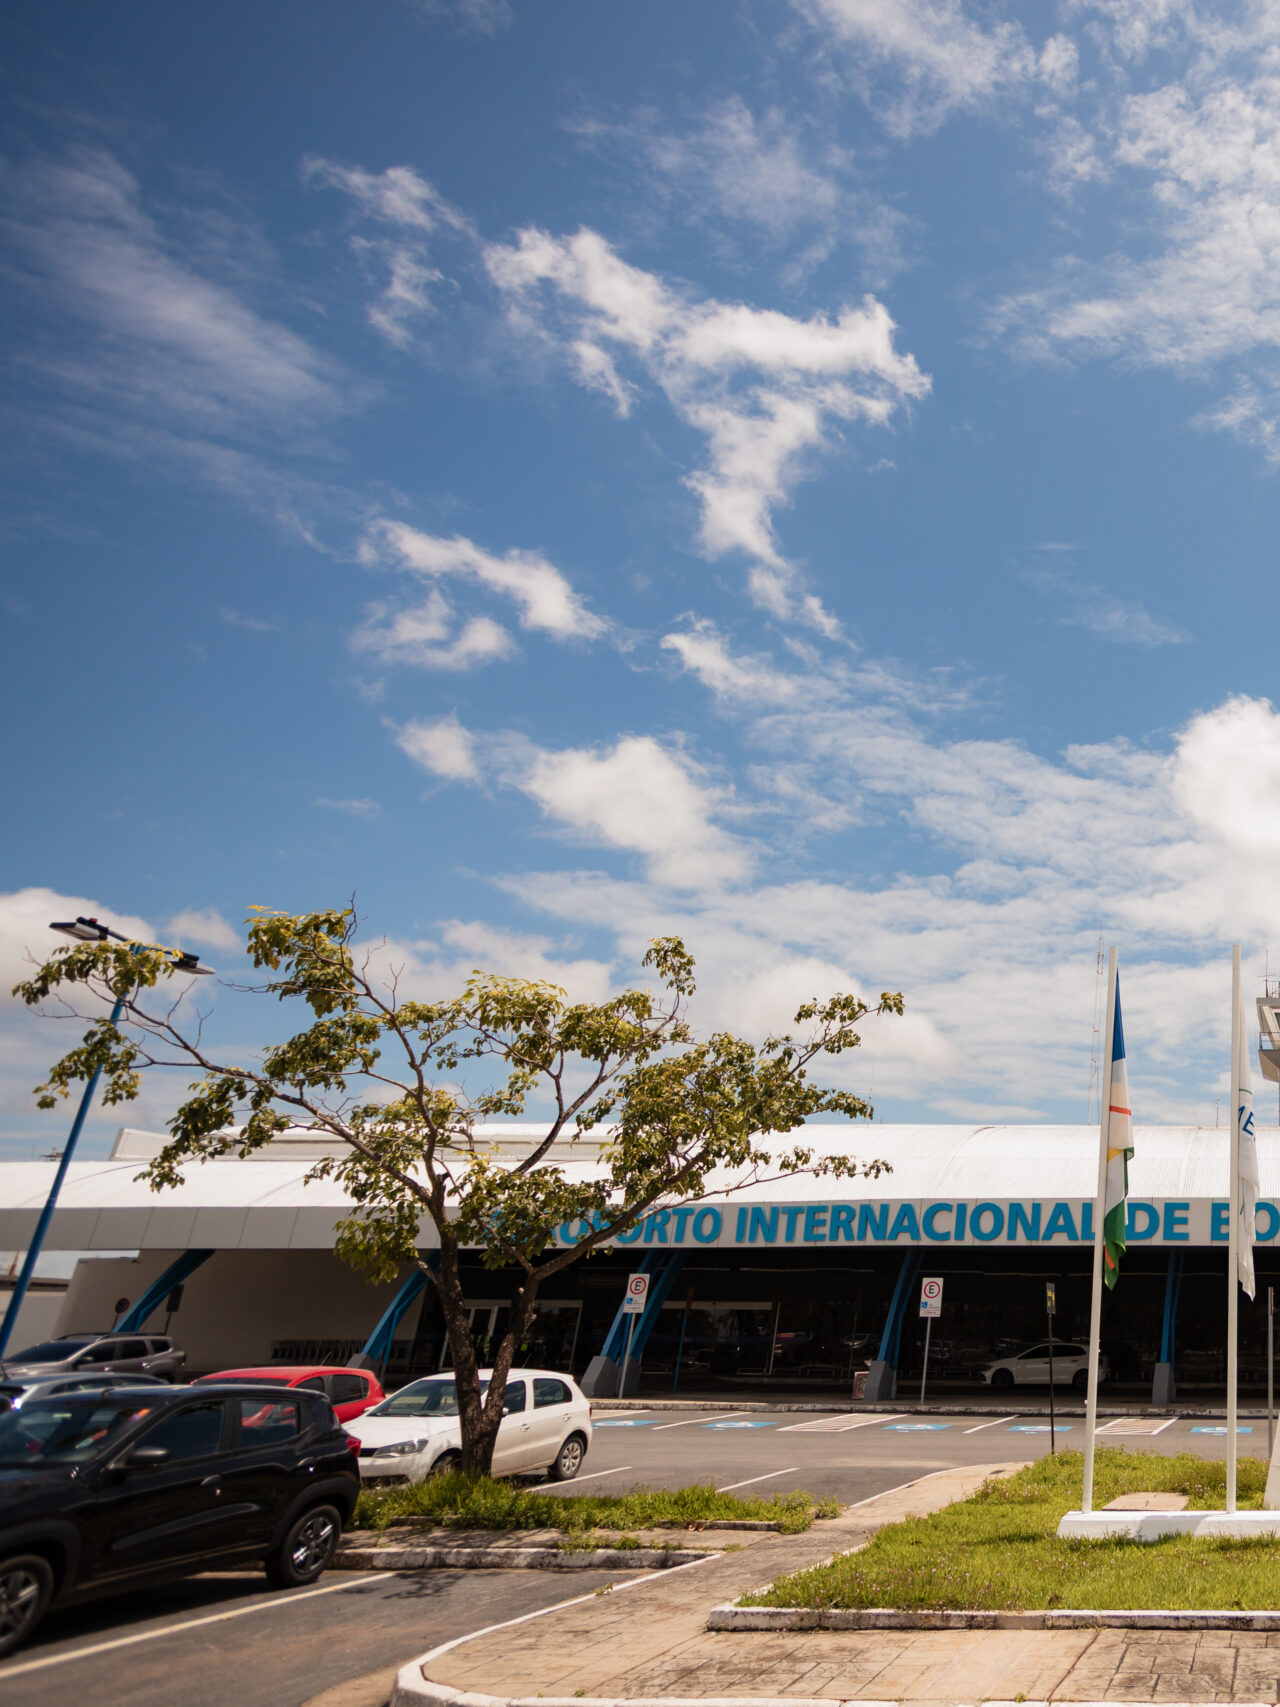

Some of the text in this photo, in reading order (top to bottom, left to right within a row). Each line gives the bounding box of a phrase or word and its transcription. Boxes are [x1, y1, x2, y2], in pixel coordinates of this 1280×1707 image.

[480, 1206, 723, 1245] OORTO
[734, 1202, 1096, 1243] INTERNACIONAL
[1124, 1202, 1190, 1241] DE
[634, 1280, 642, 1291] E
[928, 1284, 935, 1295] E
